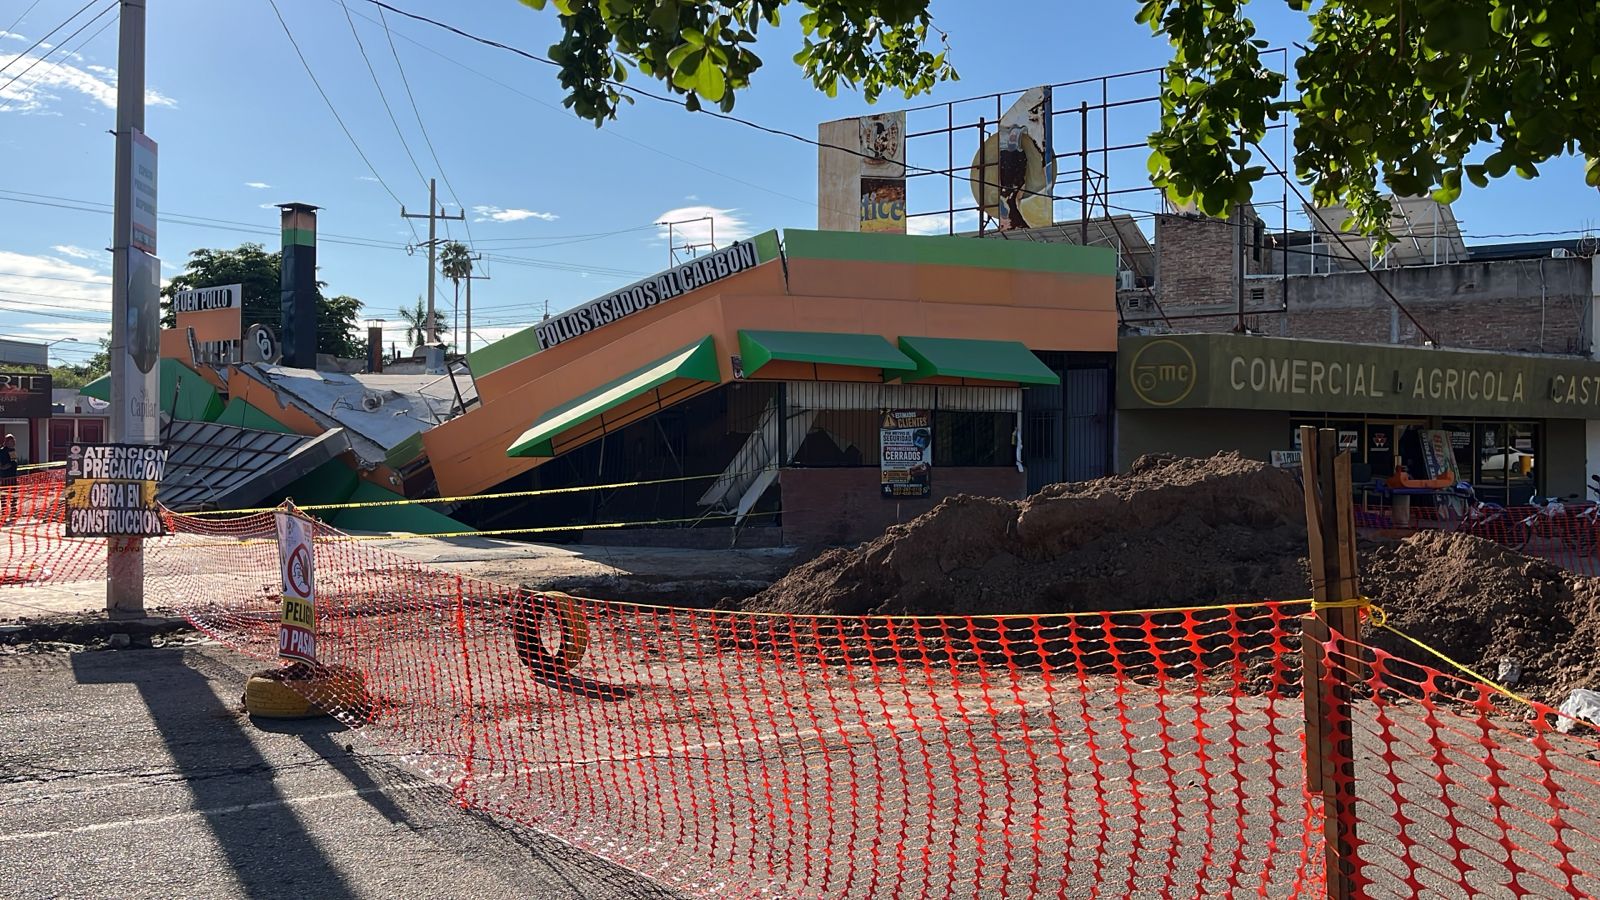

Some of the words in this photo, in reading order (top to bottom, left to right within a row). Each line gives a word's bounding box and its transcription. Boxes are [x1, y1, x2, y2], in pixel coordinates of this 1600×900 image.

[174, 292, 198, 312] BUEN
[201, 289, 230, 310] POLLO
[534, 308, 592, 350] POLLOS
[590, 280, 658, 327] ASADOS
[657, 270, 681, 301] AL
[1230, 356, 1384, 397] COMERCIAL
[1412, 367, 1524, 403] AGRICOLA
[897, 416, 928, 428] CLIENTES
[83, 446, 169, 461] ATENCIÓN
[885, 451, 921, 461] CERRADOS
[91, 483, 124, 507] OBRA
[127, 484, 140, 507] EN
